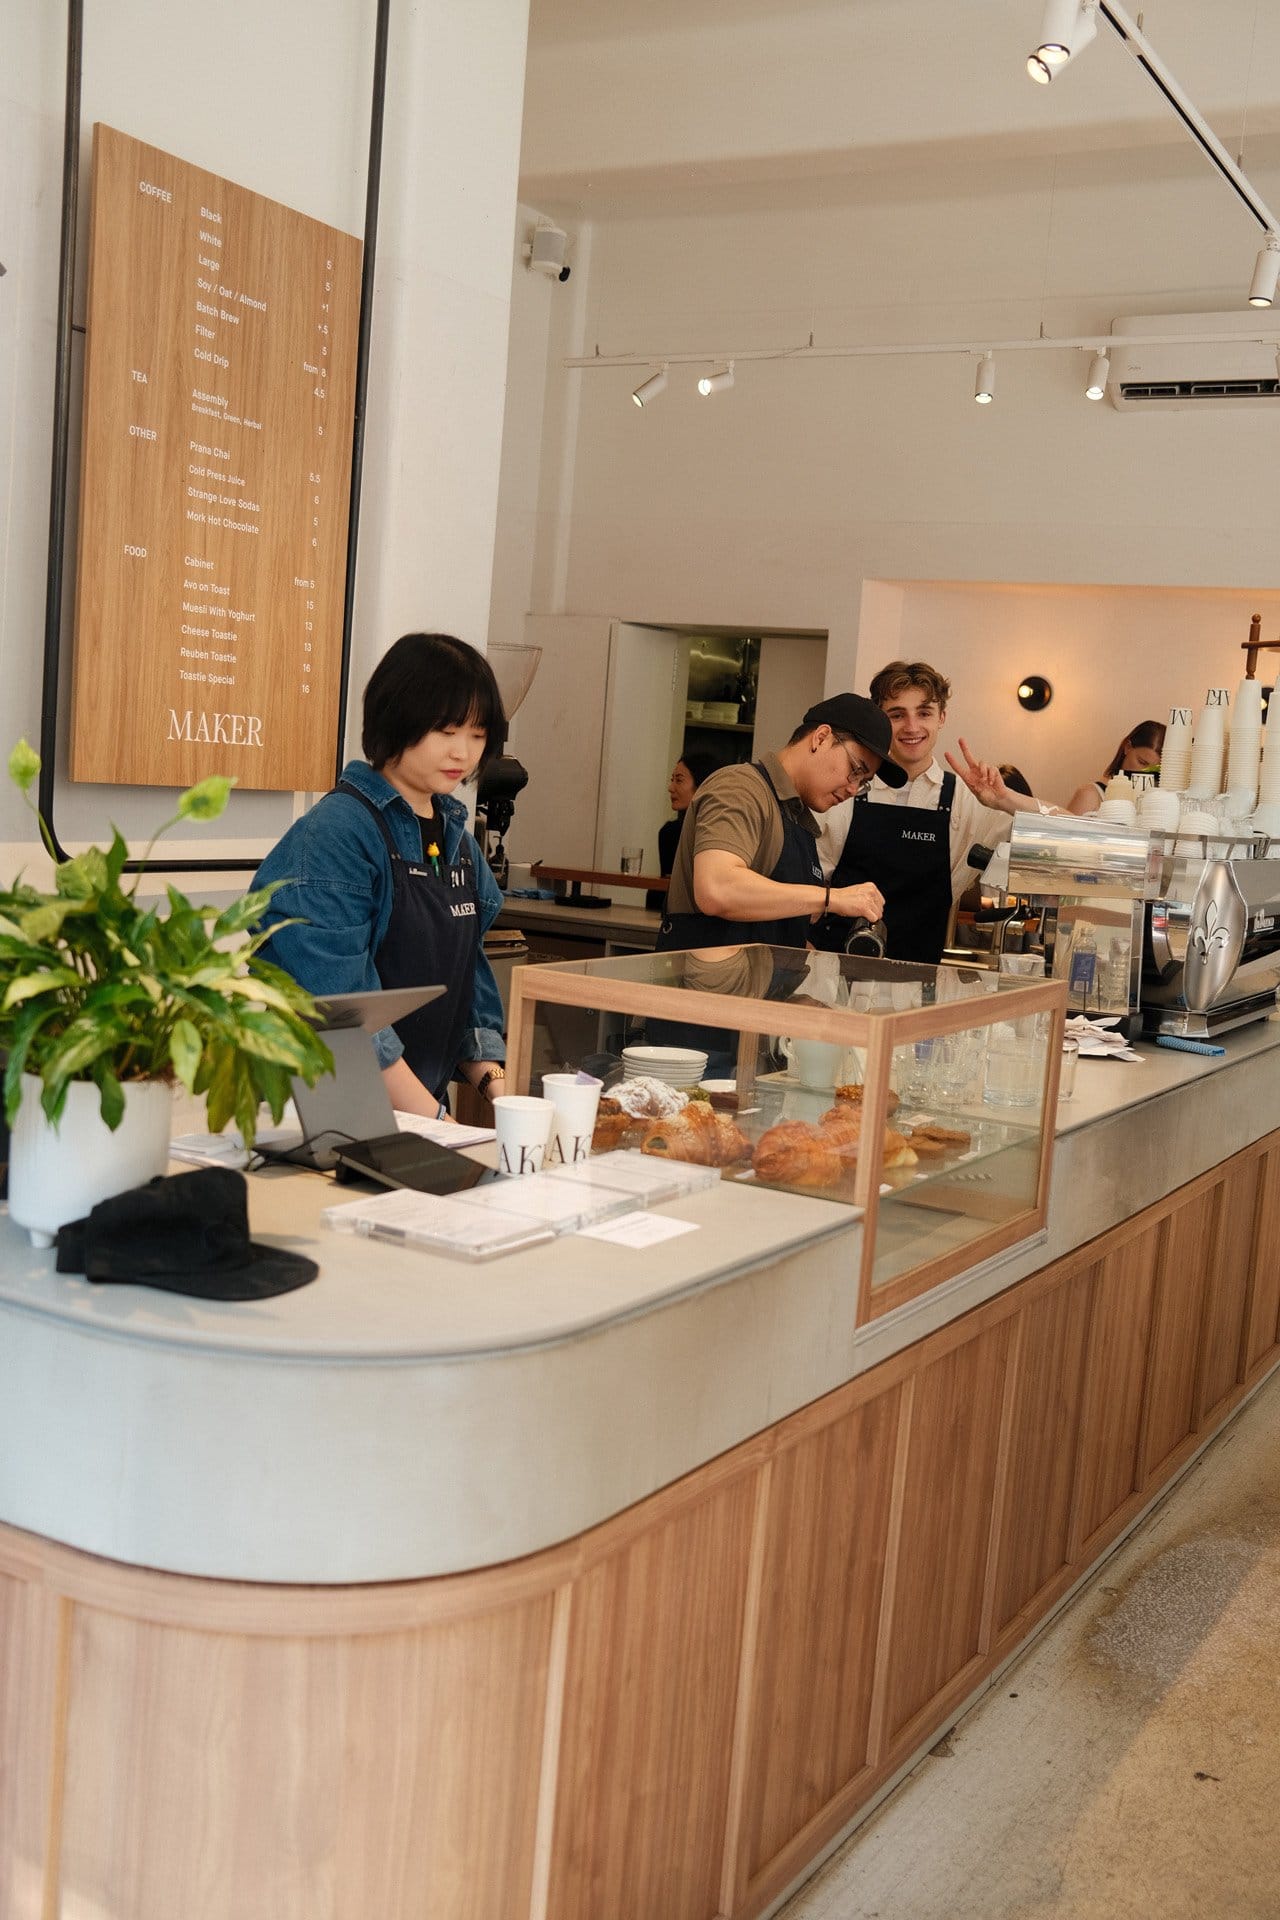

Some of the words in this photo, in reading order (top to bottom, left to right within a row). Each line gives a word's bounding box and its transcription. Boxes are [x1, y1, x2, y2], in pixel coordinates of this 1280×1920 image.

[139, 181, 172, 203] COFFEE
[200, 207, 222, 224] Black
[199, 231, 222, 248] White
[198, 254, 220, 272] Large
[326, 260, 332, 270] 5
[197, 278, 212, 293] Soy
[219, 286, 232, 299] Oat
[239, 294, 267, 312] Almond
[196, 301, 218, 318] Batch
[220, 310, 240, 325] Brew
[195, 324, 215, 339] Filter
[194, 348, 212, 362] Cold
[213, 354, 230, 369] Drip
[303, 361, 319, 375] from
[131, 370, 148, 384] TEA
[192, 388, 229, 409] Assembly
[129, 425, 157, 441] OTHER
[318, 426, 323, 436] 5
[189, 441, 212, 456] Prana
[213, 447, 231, 460] Chai
[189, 465, 206, 477] Cold
[206, 468, 226, 482] Press
[227, 475, 246, 487] Juice
[187, 486, 218, 503] Strange
[219, 494, 237, 507] Love
[238, 499, 260, 512] Sodas
[187, 510, 206, 522] Mork
[207, 515, 221, 526] Hot
[222, 518, 259, 534] Chocolate
[312, 517, 319, 526] 5
[124, 544, 147, 558] FOOD
[184, 556, 214, 570] Cabinet
[183, 579, 198, 590] Avo
[198, 583, 209, 592] on
[210, 583, 231, 595] Toast
[294, 577, 310, 588] from
[310, 581, 315, 589] 5
[182, 602, 208, 614] Muesli
[208, 606, 227, 618] With
[228, 608, 256, 622] Yoghurt
[306, 601, 314, 610] 15
[181, 624, 210, 638] Cheese
[210, 628, 238, 641] Toastie
[305, 621, 313, 631] 13
[304, 642, 312, 652] 13
[180, 647, 209, 660] Reuben
[209, 651, 237, 664] Toastie
[179, 669, 207, 682] Toastie
[207, 673, 235, 685] Special
[167, 708, 264, 747] MAKER
[901, 830, 937, 842] MAKER
